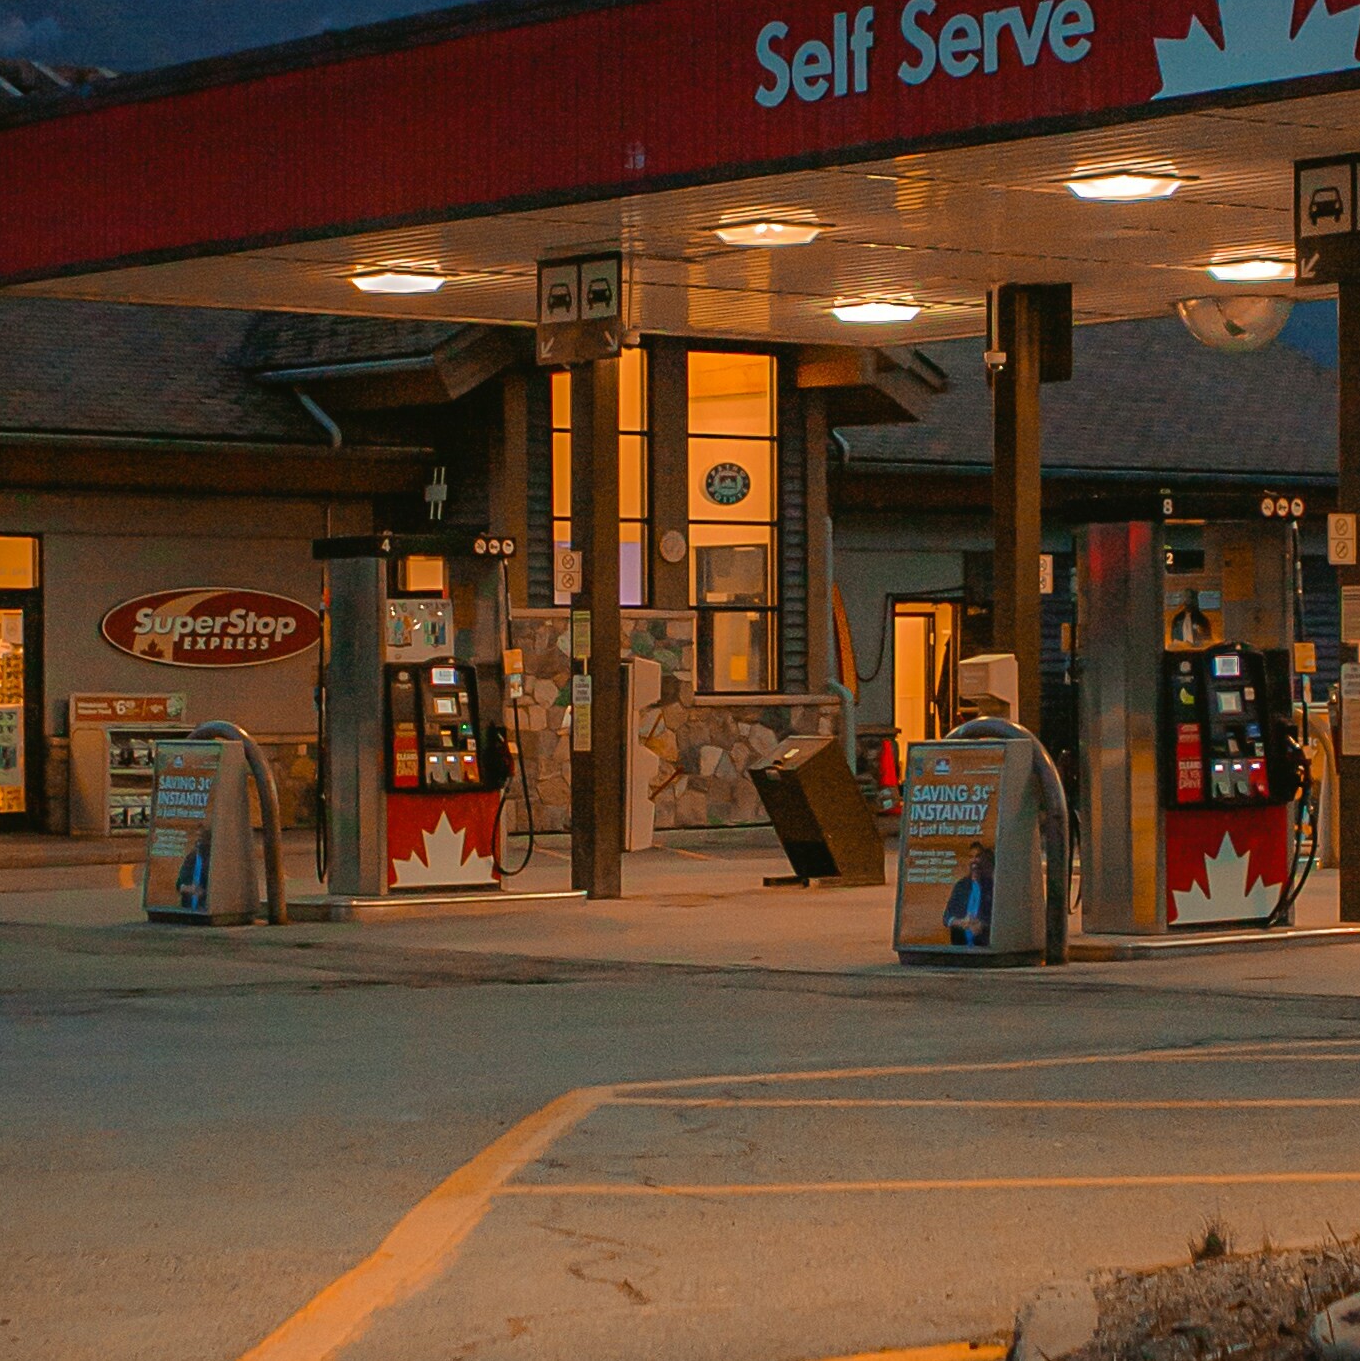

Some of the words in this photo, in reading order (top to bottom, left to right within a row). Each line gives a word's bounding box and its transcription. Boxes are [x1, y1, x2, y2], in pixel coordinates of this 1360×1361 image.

[754, 5, 875, 108] Self
[1163, 498, 1173, 515] 8
[382, 538, 391, 552] 4
[134, 607, 296, 641] SuperStop
[183, 637, 270, 650] EXPRESS
[159, 776, 196, 790] SAVING
[158, 792, 208, 807] INSTANTLY
[912, 785, 969, 802] SAVING
[910, 804, 988, 821] INSTANTLY
[919, 822, 937, 838] just
[939, 822, 955, 835] the
